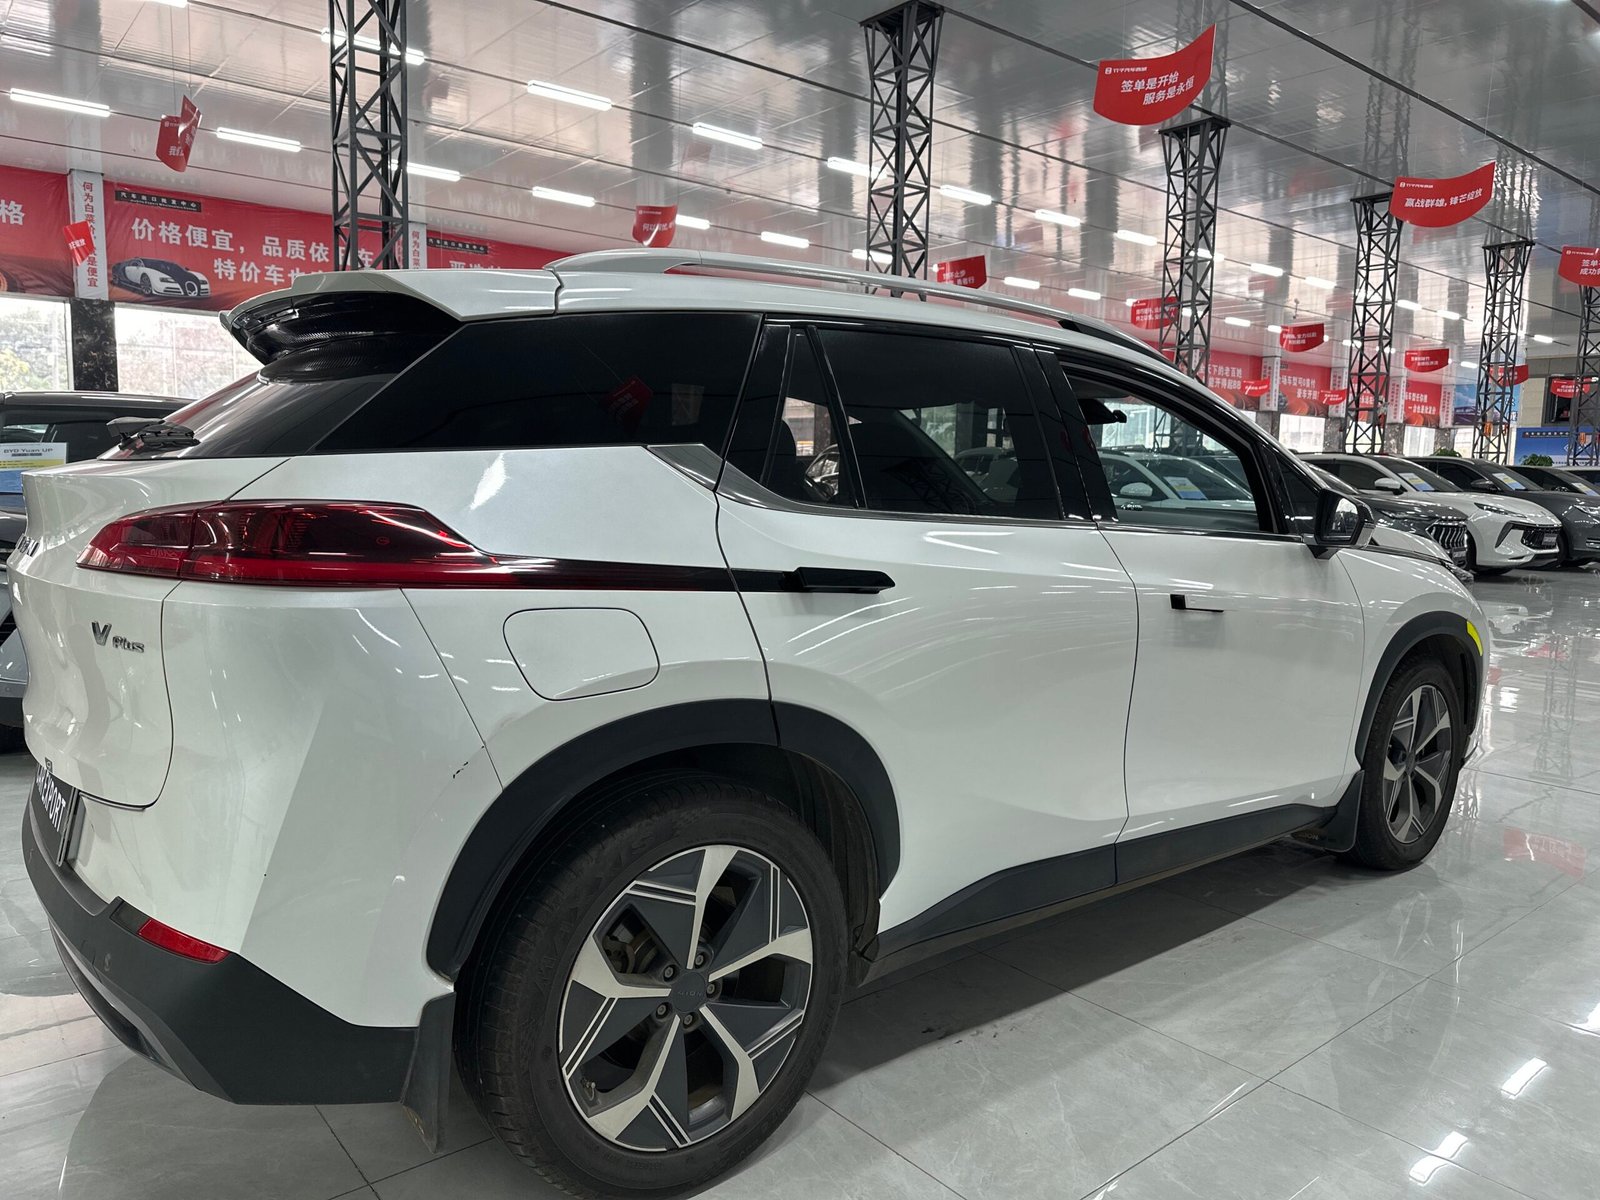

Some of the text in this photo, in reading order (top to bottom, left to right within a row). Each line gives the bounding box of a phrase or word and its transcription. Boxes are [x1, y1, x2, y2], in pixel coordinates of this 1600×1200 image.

[1121, 71, 1179, 93] 签单是开始
[1142, 75, 1195, 106] 服务是永恒
[411, 230, 421, 269] 何为白菜
[1581, 259, 1600, 267] 签单
[91, 621, 145, 654] V Plus
